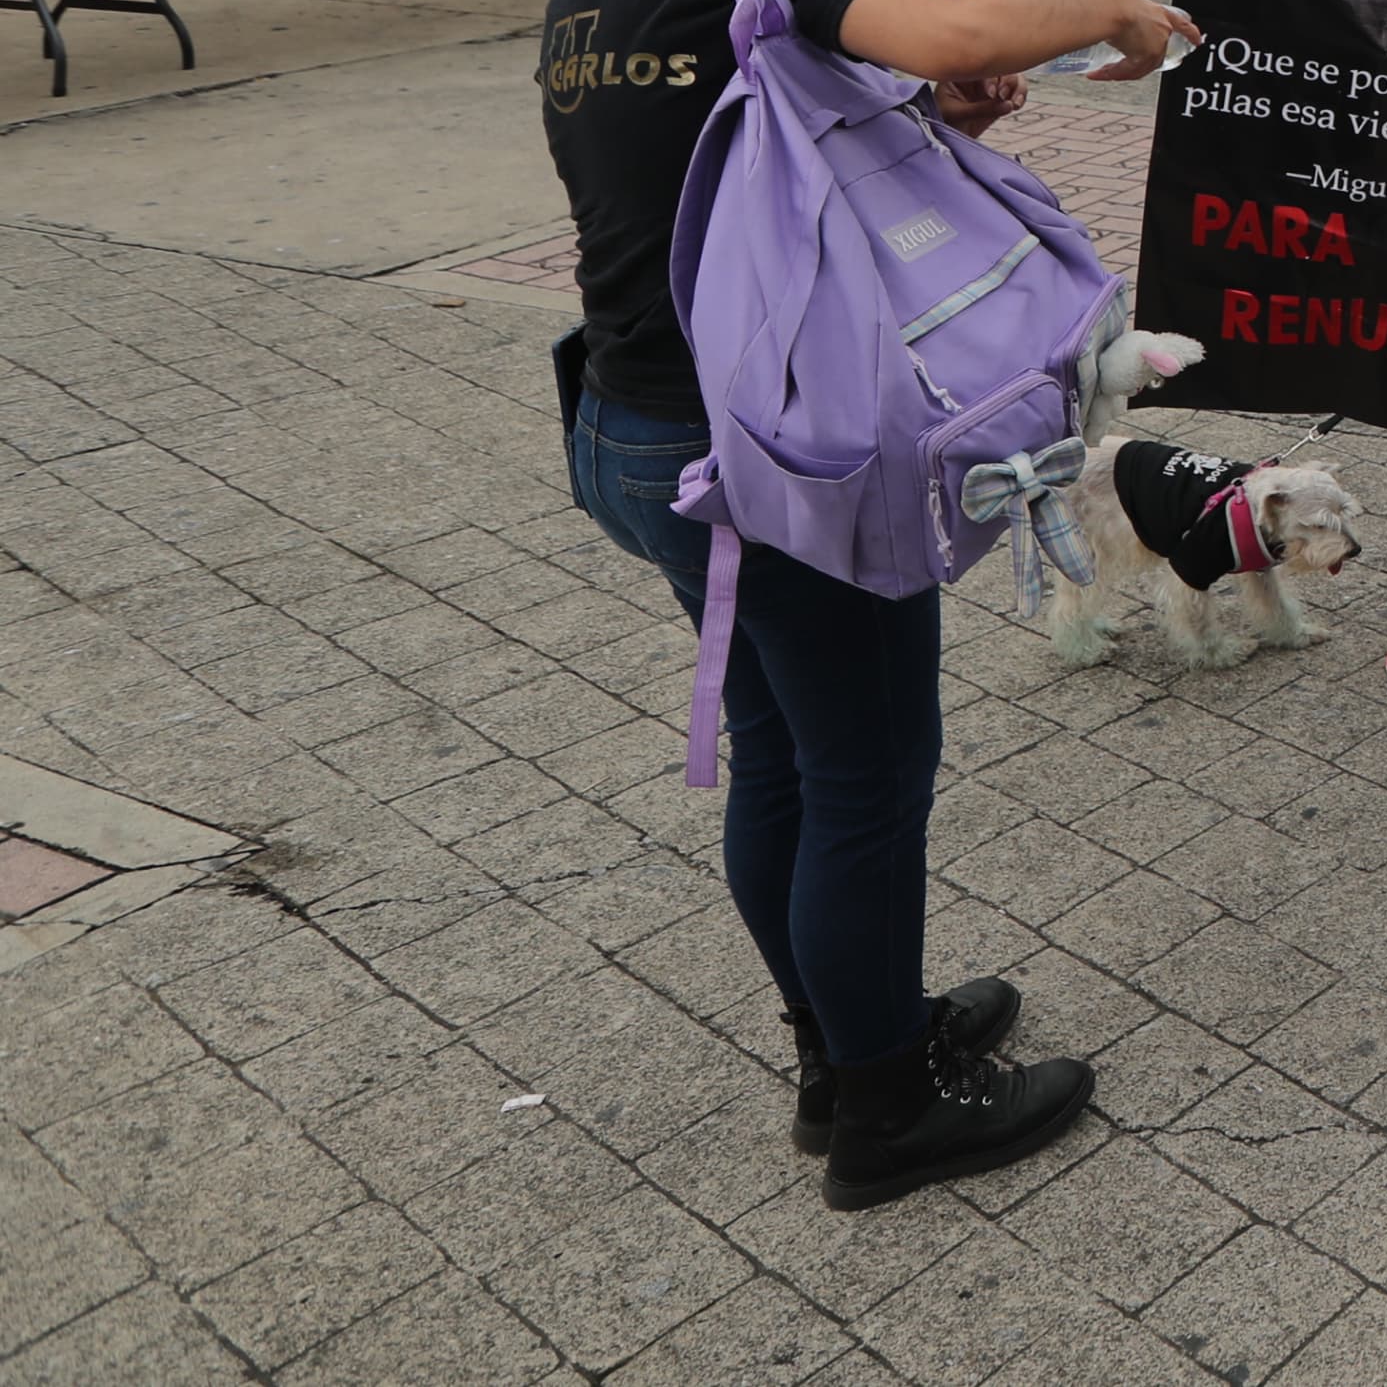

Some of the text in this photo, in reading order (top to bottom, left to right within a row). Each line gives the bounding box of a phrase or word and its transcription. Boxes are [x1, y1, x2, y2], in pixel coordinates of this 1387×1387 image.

[551, 52, 699, 93] CARLOS
[1303, 59, 1340, 85] se
[1181, 82, 1272, 118] pilas
[1281, 101, 1337, 131] esa
[894, 218, 947, 253] XIGUL
[1191, 193, 1356, 266] PARA
